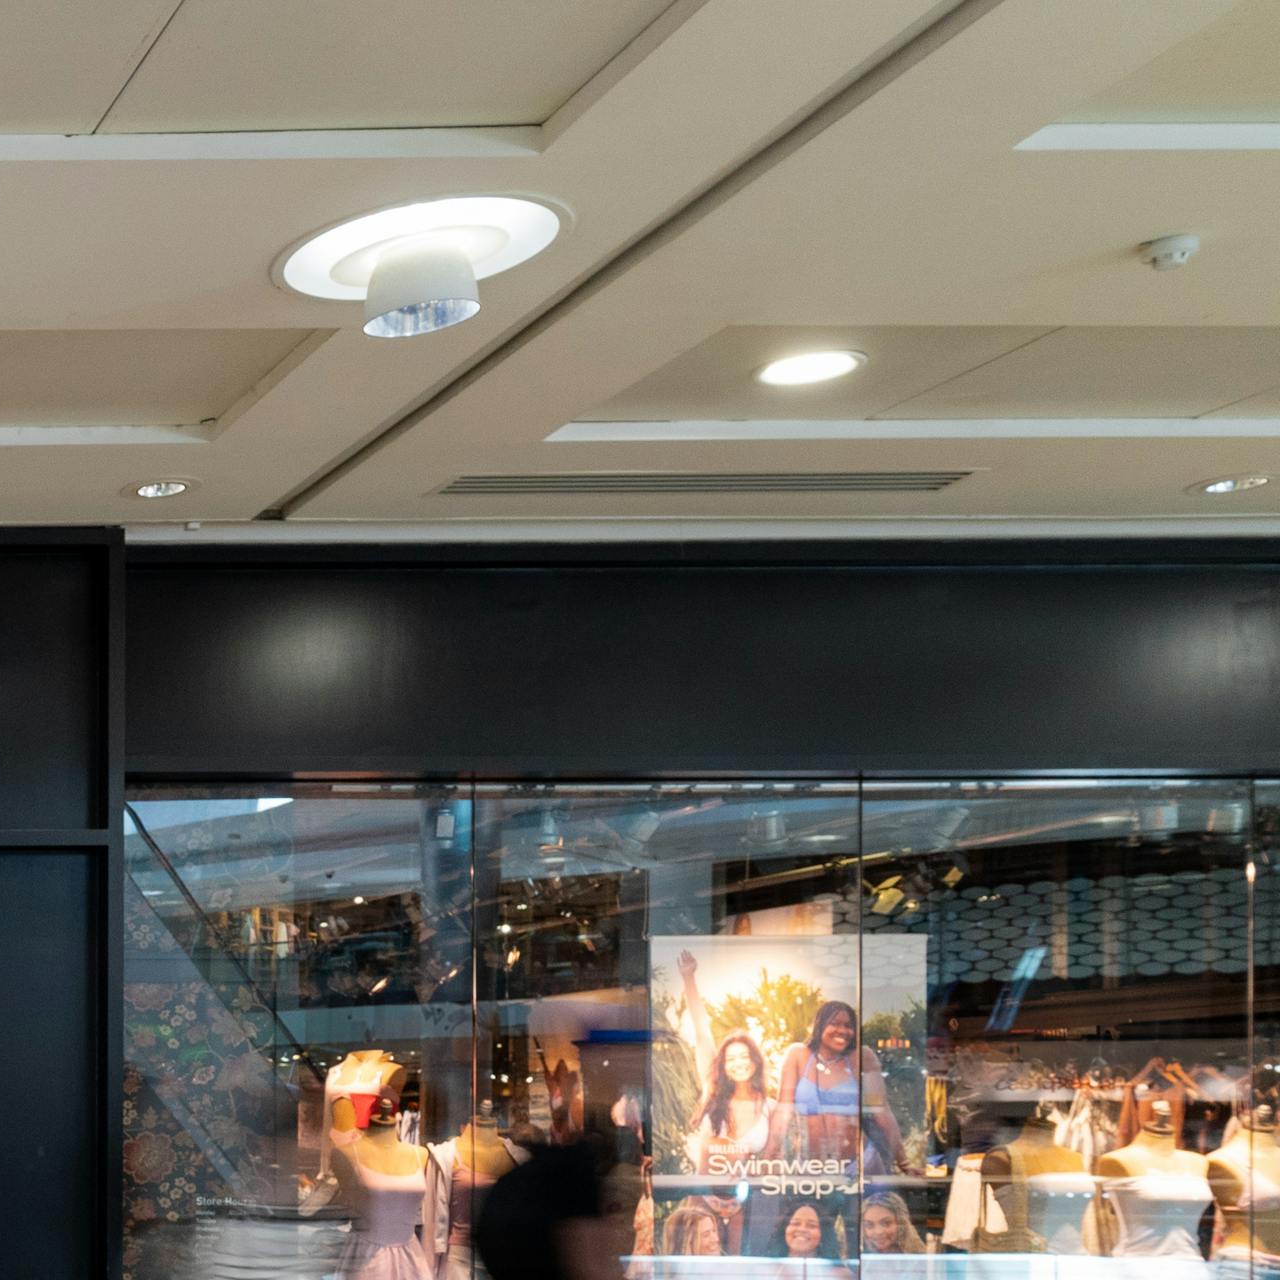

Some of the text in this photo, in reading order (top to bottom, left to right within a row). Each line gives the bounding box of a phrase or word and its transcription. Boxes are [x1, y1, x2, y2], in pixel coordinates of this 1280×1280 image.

[707, 1154, 851, 1176] Swimwear
[760, 1174, 834, 1200] Shop
[196, 1196, 222, 1207] Store
